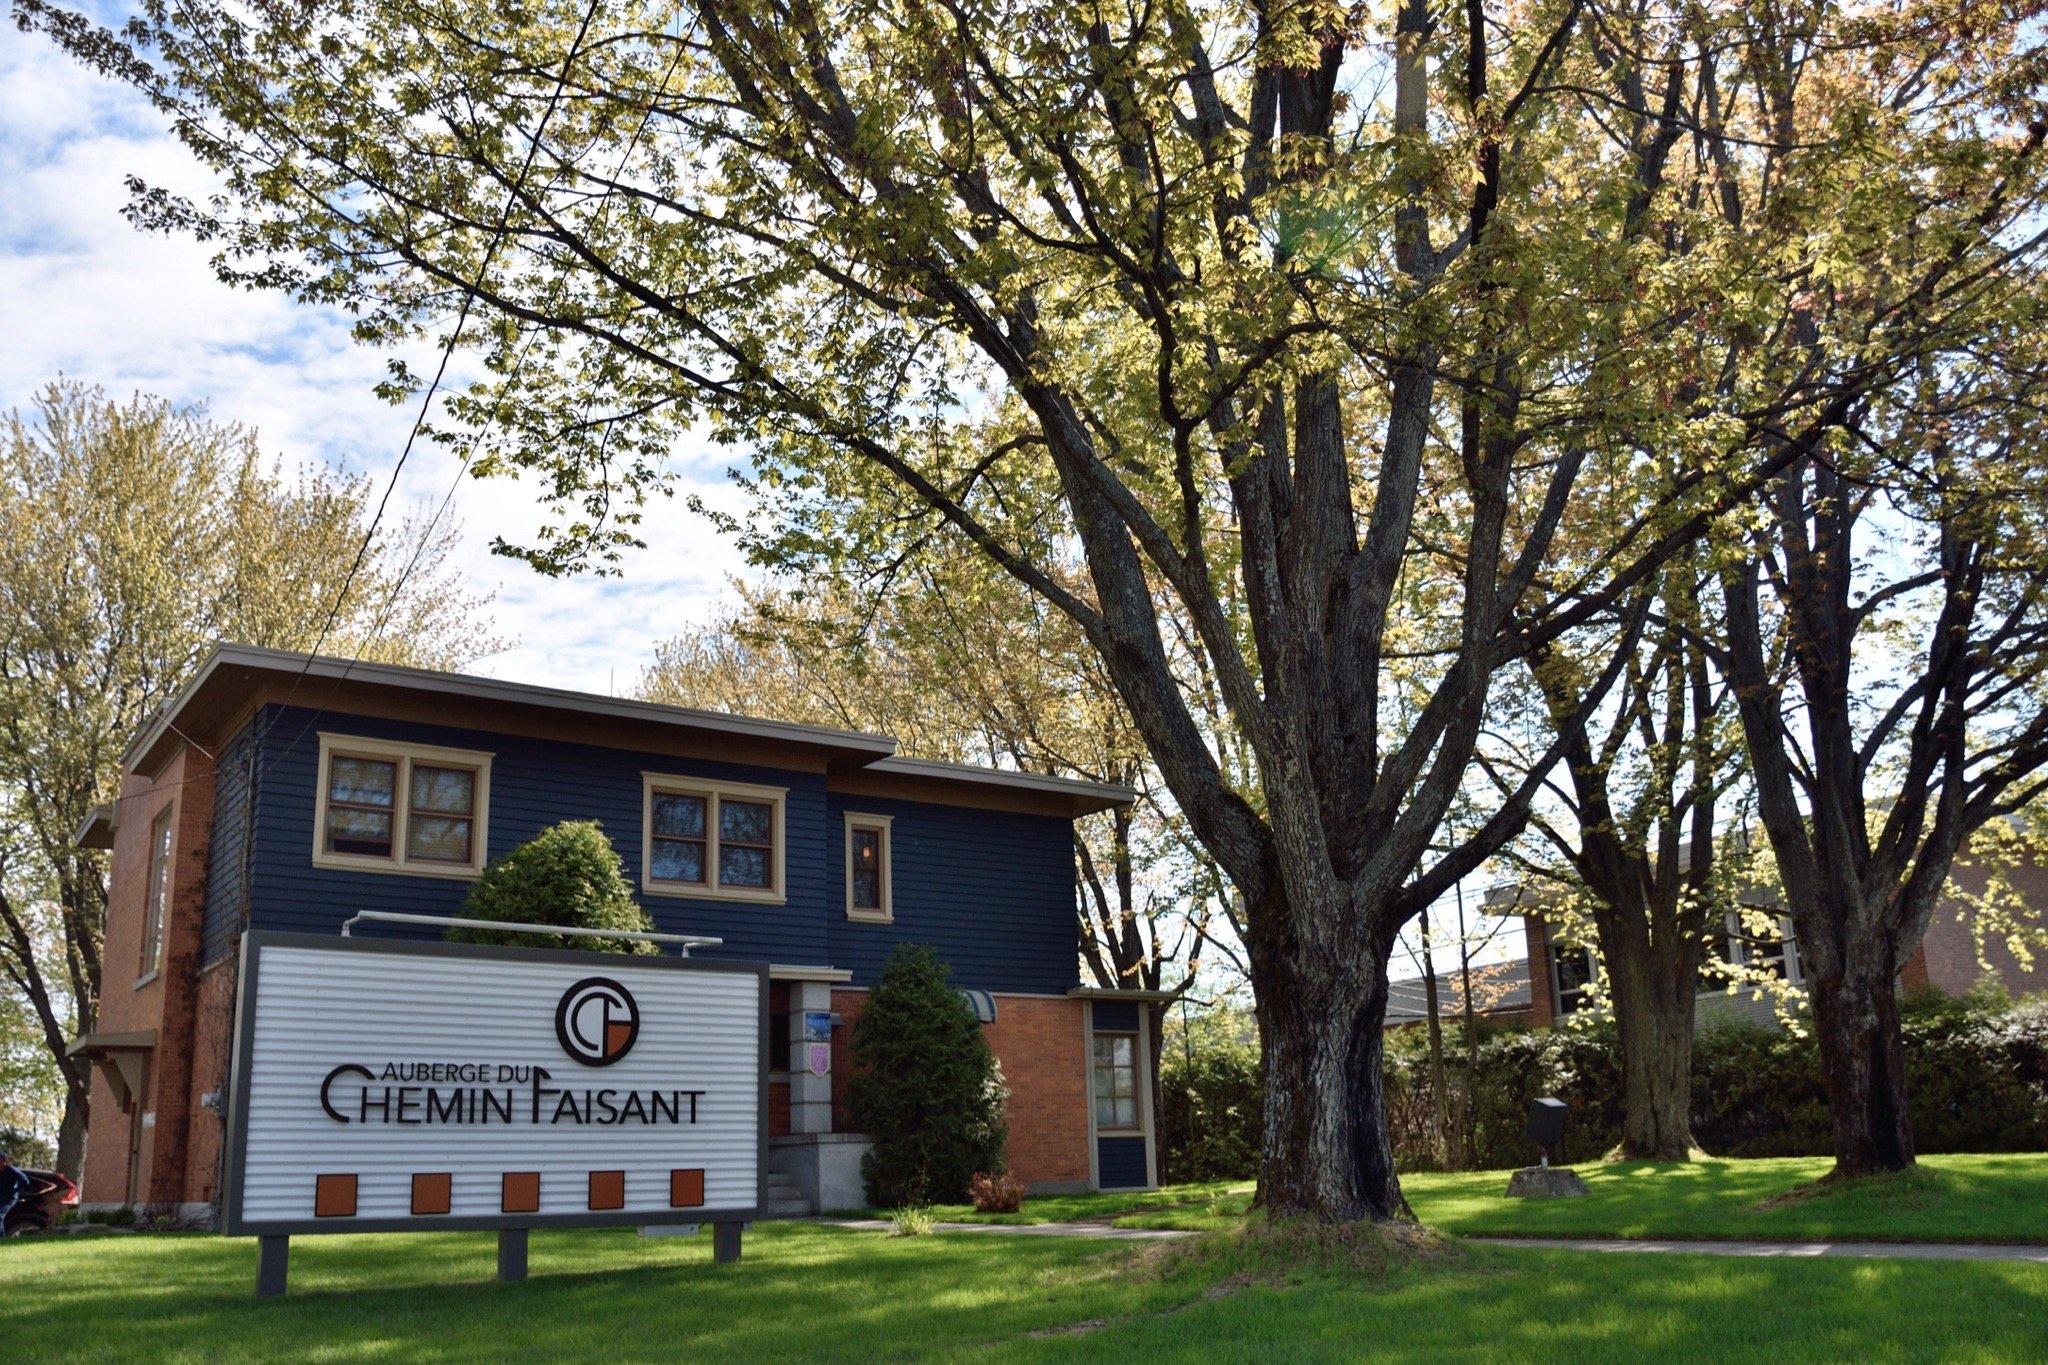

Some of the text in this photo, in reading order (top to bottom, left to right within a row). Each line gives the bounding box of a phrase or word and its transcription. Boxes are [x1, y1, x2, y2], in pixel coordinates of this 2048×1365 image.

[320, 1063, 706, 1124] CHEMIN FAISANT
[381, 1062, 530, 1084] AUBERGE DU
